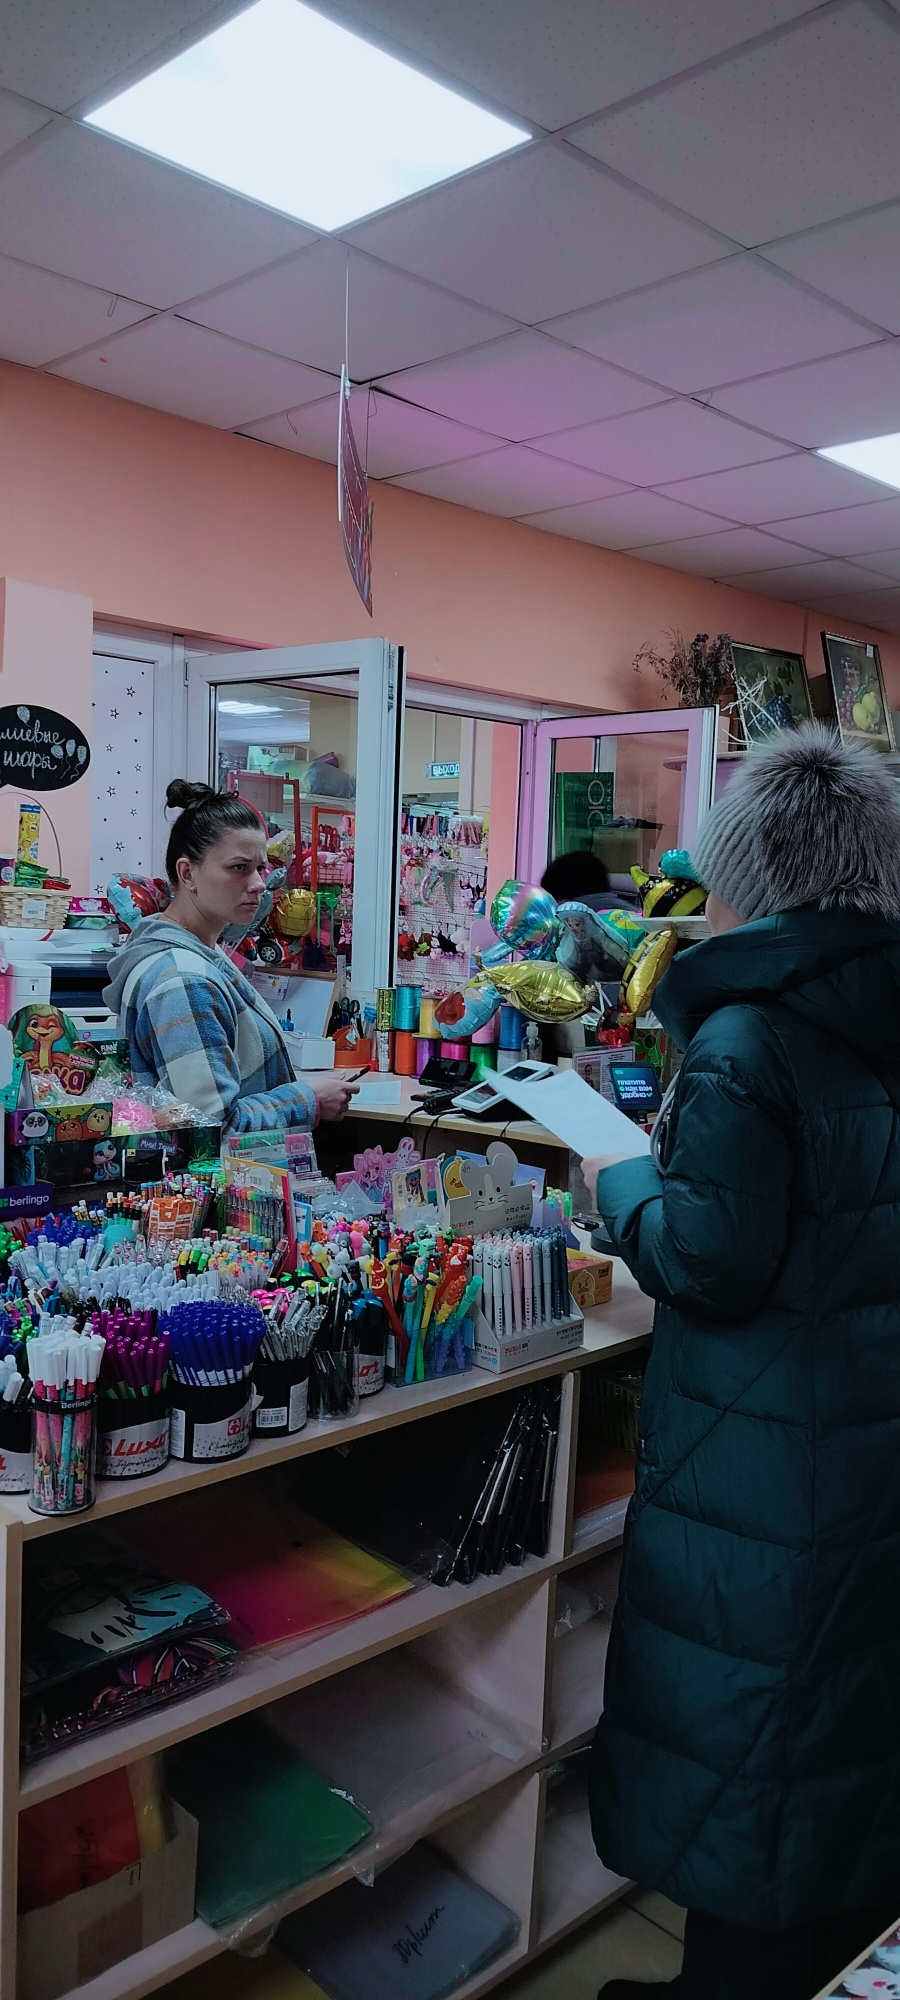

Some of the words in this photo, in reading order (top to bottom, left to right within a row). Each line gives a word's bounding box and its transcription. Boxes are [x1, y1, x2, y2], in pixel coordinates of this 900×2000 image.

[3, 750, 57, 779] шары
[433, 763, 460, 775] ВЫХОД
[620, 1091, 647, 1100] удобно
[9, 1193, 50, 1208] berlingo
[61, 1399, 92, 1409] Berlingo
